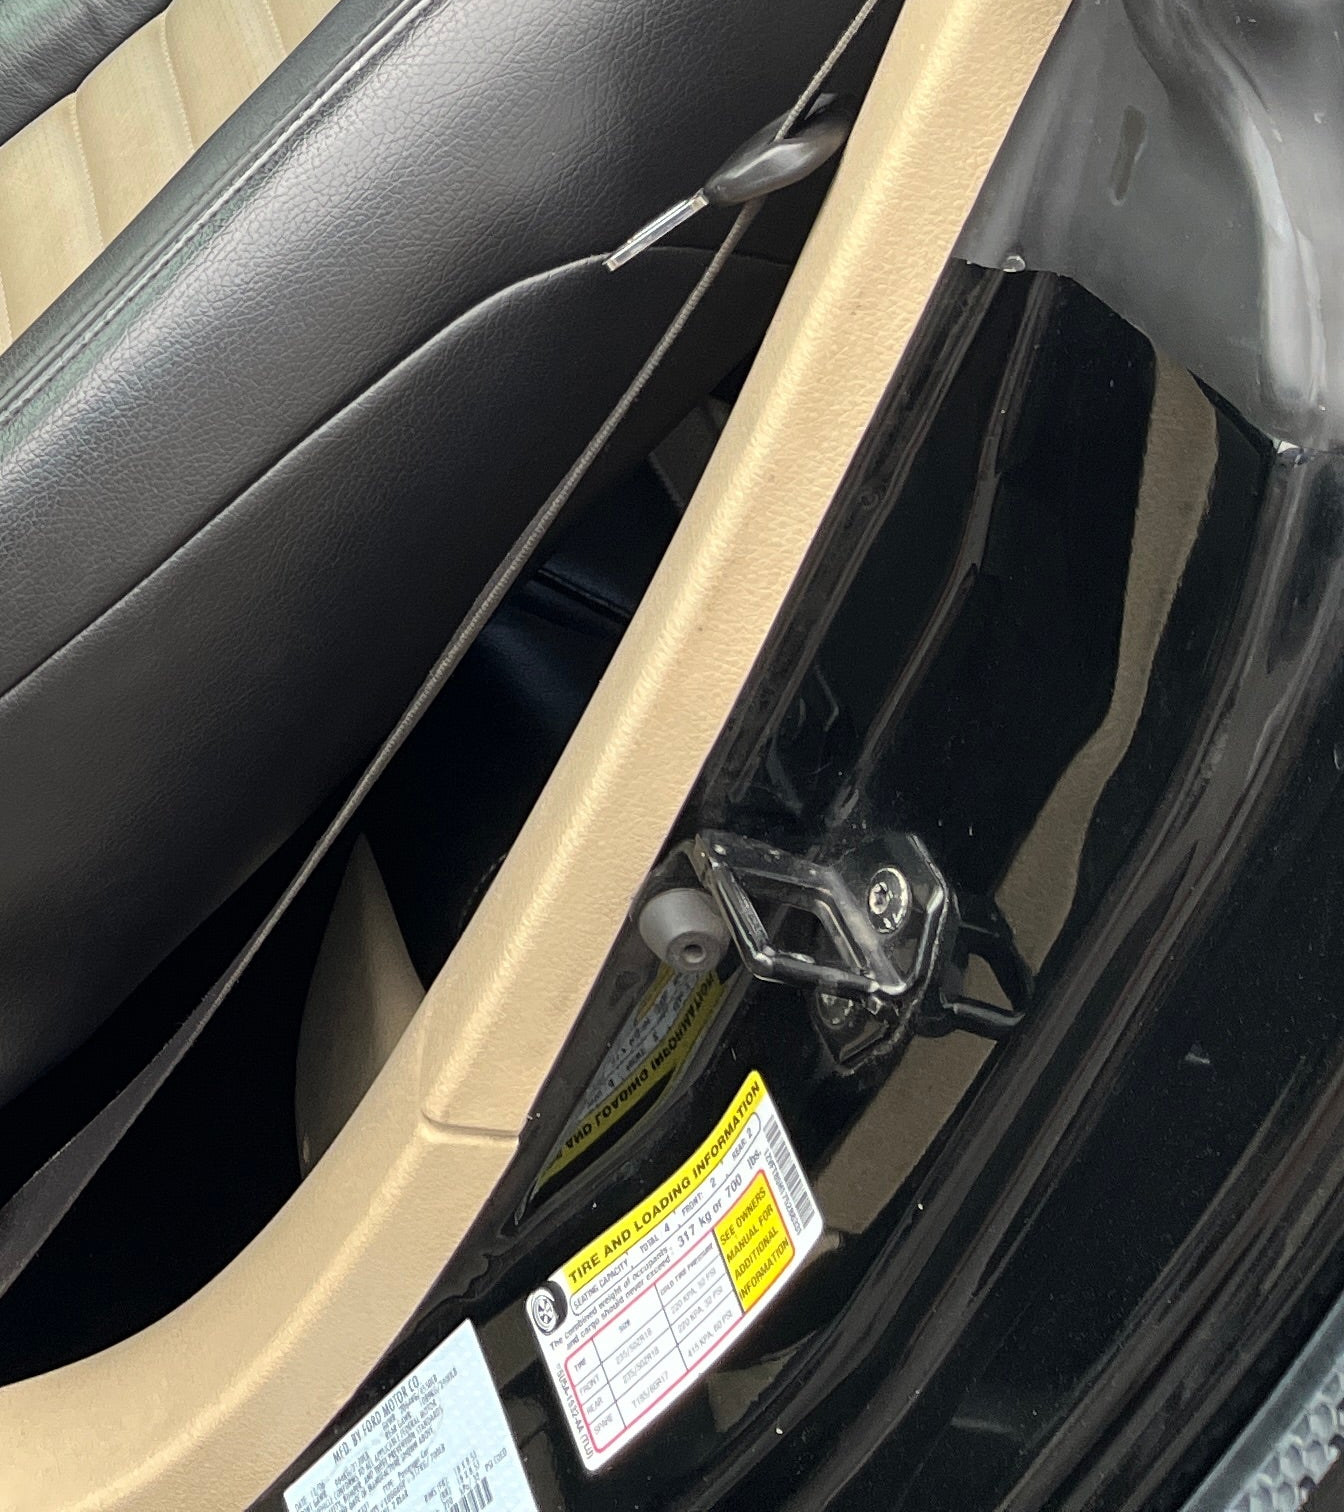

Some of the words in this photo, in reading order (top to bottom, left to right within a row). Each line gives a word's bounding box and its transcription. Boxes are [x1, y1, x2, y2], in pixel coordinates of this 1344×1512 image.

[568, 1253, 600, 1283] TIRE
[604, 1229, 631, 1258] AND
[634, 1177, 690, 1231] LOADING
[693, 1081, 760, 1177] INFORMATION
[720, 1224, 736, 1245] SEE
[736, 1187, 766, 1227] OWNERS
[574, 1284, 599, 1309] SEATING
[599, 1259, 628, 1288] CAPACITY
[664, 1222, 670, 1232] 4
[710, 1177, 717, 1188] 2
[746, 1127, 753, 1138] 2
[726, 1225, 759, 1263] MANUAL
[758, 1204, 774, 1226] FOR
[549, 1337, 563, 1350] The
[598, 1286, 622, 1309] weight
[677, 1224, 695, 1247] 317
[698, 1211, 712, 1226] kg
[712, 1198, 722, 1213] or
[725, 1173, 742, 1198] 700
[735, 1227, 778, 1279] ADDITIONAL
[737, 1238, 789, 1299] INFORMATION
[332, 1442, 351, 1464] MFD.
[350, 1429, 362, 1447] BY
[362, 1411, 382, 1436] FORD
[382, 1386, 408, 1418] MOTOR
